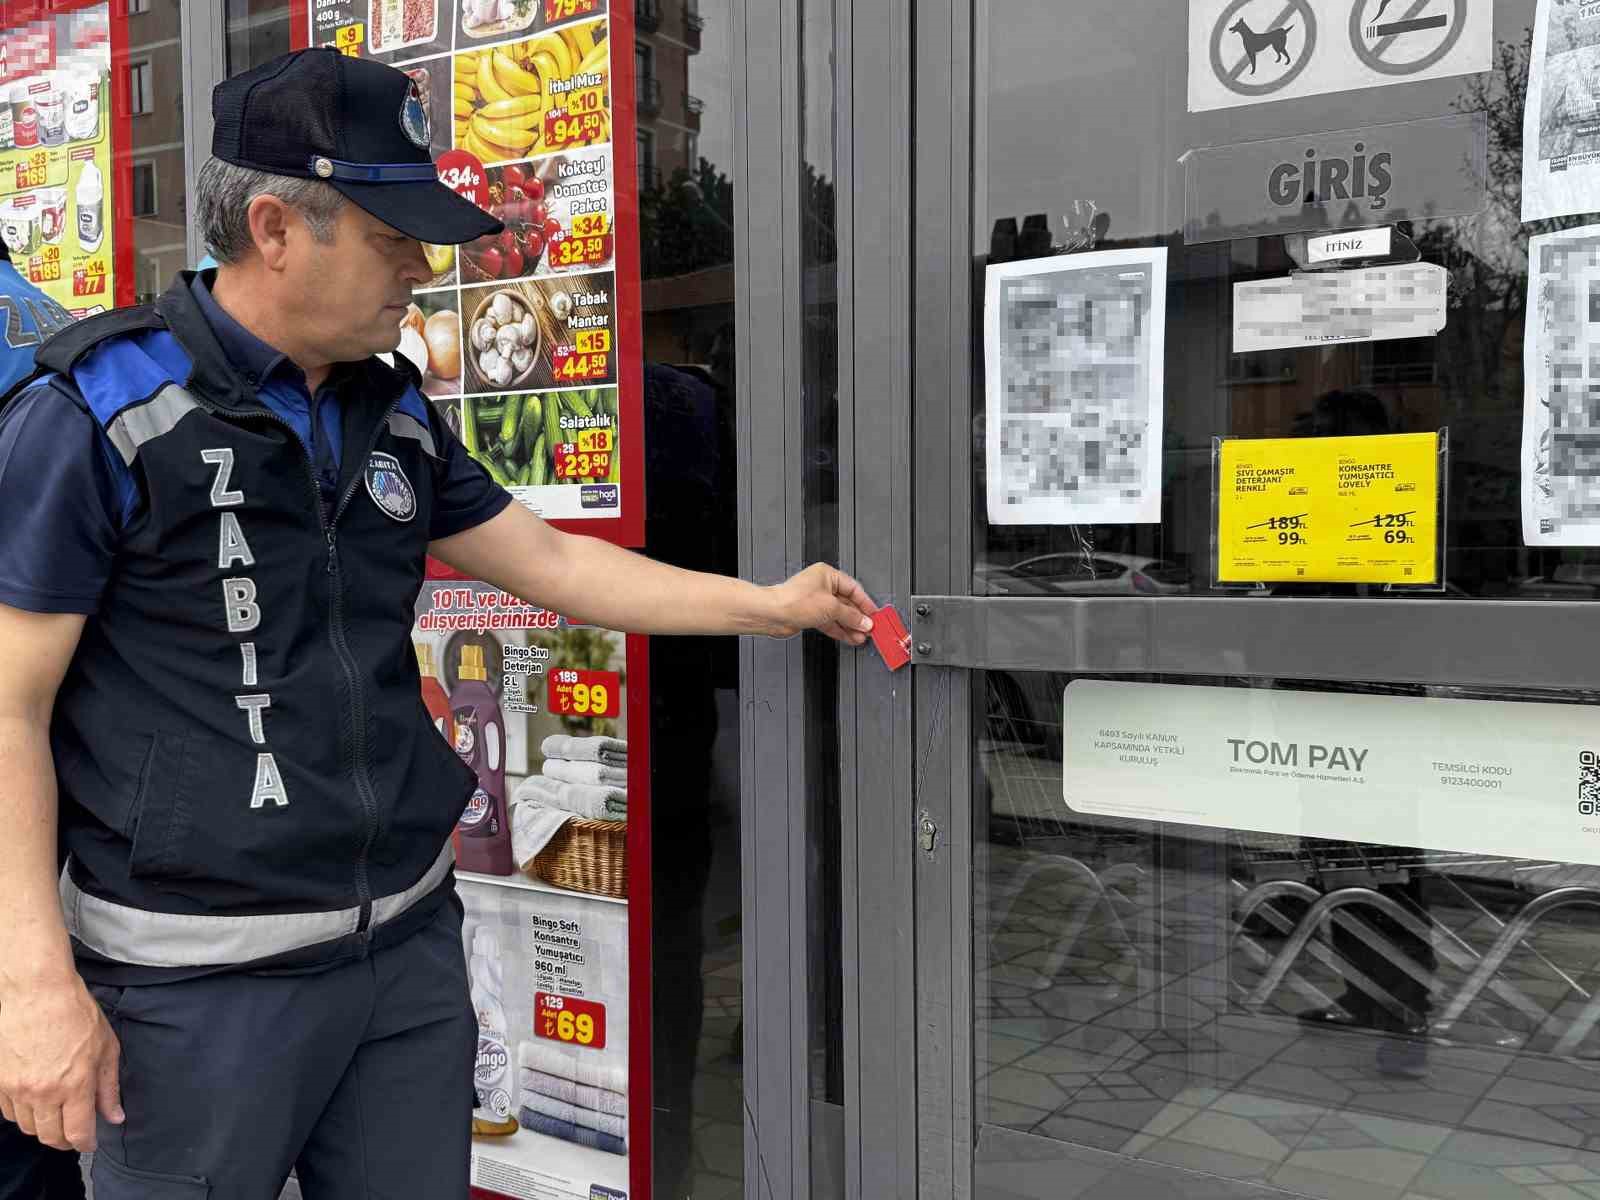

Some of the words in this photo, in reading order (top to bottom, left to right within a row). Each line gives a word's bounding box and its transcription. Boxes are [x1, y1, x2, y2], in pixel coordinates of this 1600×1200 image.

[316, 10, 334, 22] 400
[575, 73, 603, 89] Muz
[571, 91, 598, 112] %10
[558, 156, 605, 178] Kokteyl
[1268, 142, 1392, 210] GİRİŞ
[552, 180, 607, 199] Domates
[569, 198, 607, 216] Paket
[573, 216, 604, 234] %34
[573, 290, 609, 306] Tabak
[567, 314, 609, 329] Mantar
[581, 333, 604, 350] %15
[559, 413, 611, 429] Salatalık
[583, 432, 608, 450] %18
[1236, 469, 1254, 478] SIVI
[1338, 463, 1393, 473] KONSANTRE
[1338, 471, 1395, 481] YUMUŞATICI
[1236, 476, 1282, 485] DETERJANI
[1338, 480, 1371, 489] LOVELY
[432, 590, 453, 610] 10
[454, 589, 475, 609] TL
[477, 591, 497, 608] ve
[200, 447, 290, 809] ZABITA
[419, 606, 560, 635] alışverişlerinizde
[503, 645, 529, 659] Bingo
[530, 646, 548, 658] Sıvı
[503, 660, 542, 675] Deterjan
[504, 676, 510, 686] 2
[512, 676, 518, 687] L
[1145, 733, 1178, 743] KANUN
[1094, 740, 1151, 753] KAPSAMINDA
[1227, 738, 1298, 767] TOM
[1309, 744, 1369, 772] PAY
[1431, 760, 1480, 774] TEMSİLCİ
[1482, 766, 1512, 776] KODU
[1441, 776, 1502, 789] 9123400001
[532, 915, 558, 930] Bingo
[559, 919, 580, 933] Soft
[533, 930, 580, 947] Konsantre
[534, 944, 584, 963] Yumuşatıcı
[534, 960, 553, 973] 960
[475, 1051, 507, 1070] ingo
